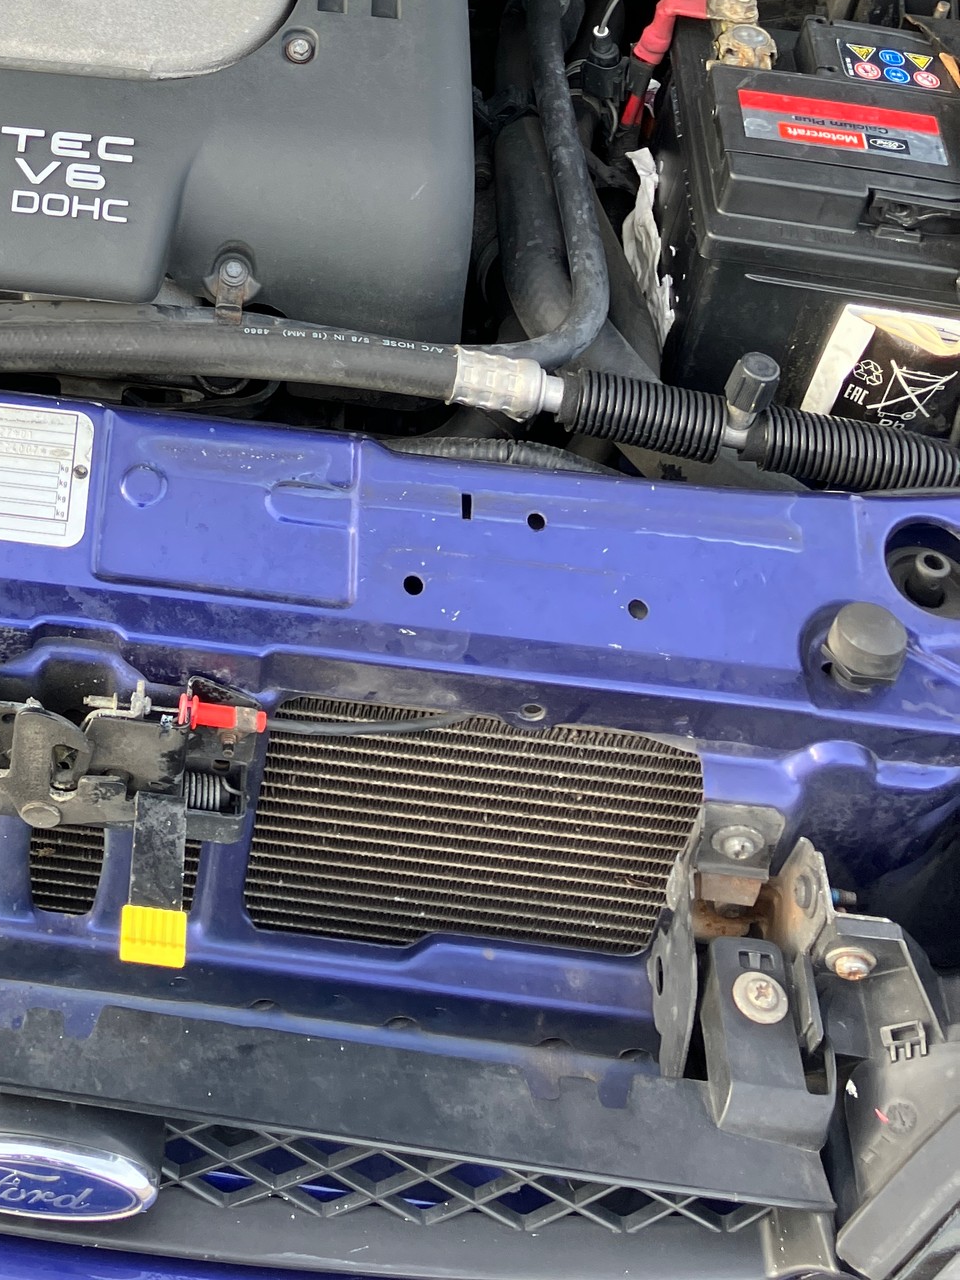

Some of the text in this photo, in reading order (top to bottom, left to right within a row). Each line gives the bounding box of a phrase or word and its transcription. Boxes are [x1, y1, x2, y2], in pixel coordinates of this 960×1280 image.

[794, 115, 889, 135] Calcium Plus
[786, 127, 858, 144] Motorcraft
[15, 157, 107, 190] V6
[11, 189, 129, 223] DOHC
[282, 329, 306, 337] MM)
[333, 333, 345, 341] IN
[351, 336, 370, 344] 5/8
[382, 338, 416, 350] HOSE
[421, 344, 445, 354] A/C
[843, 383, 870, 405] EAC
